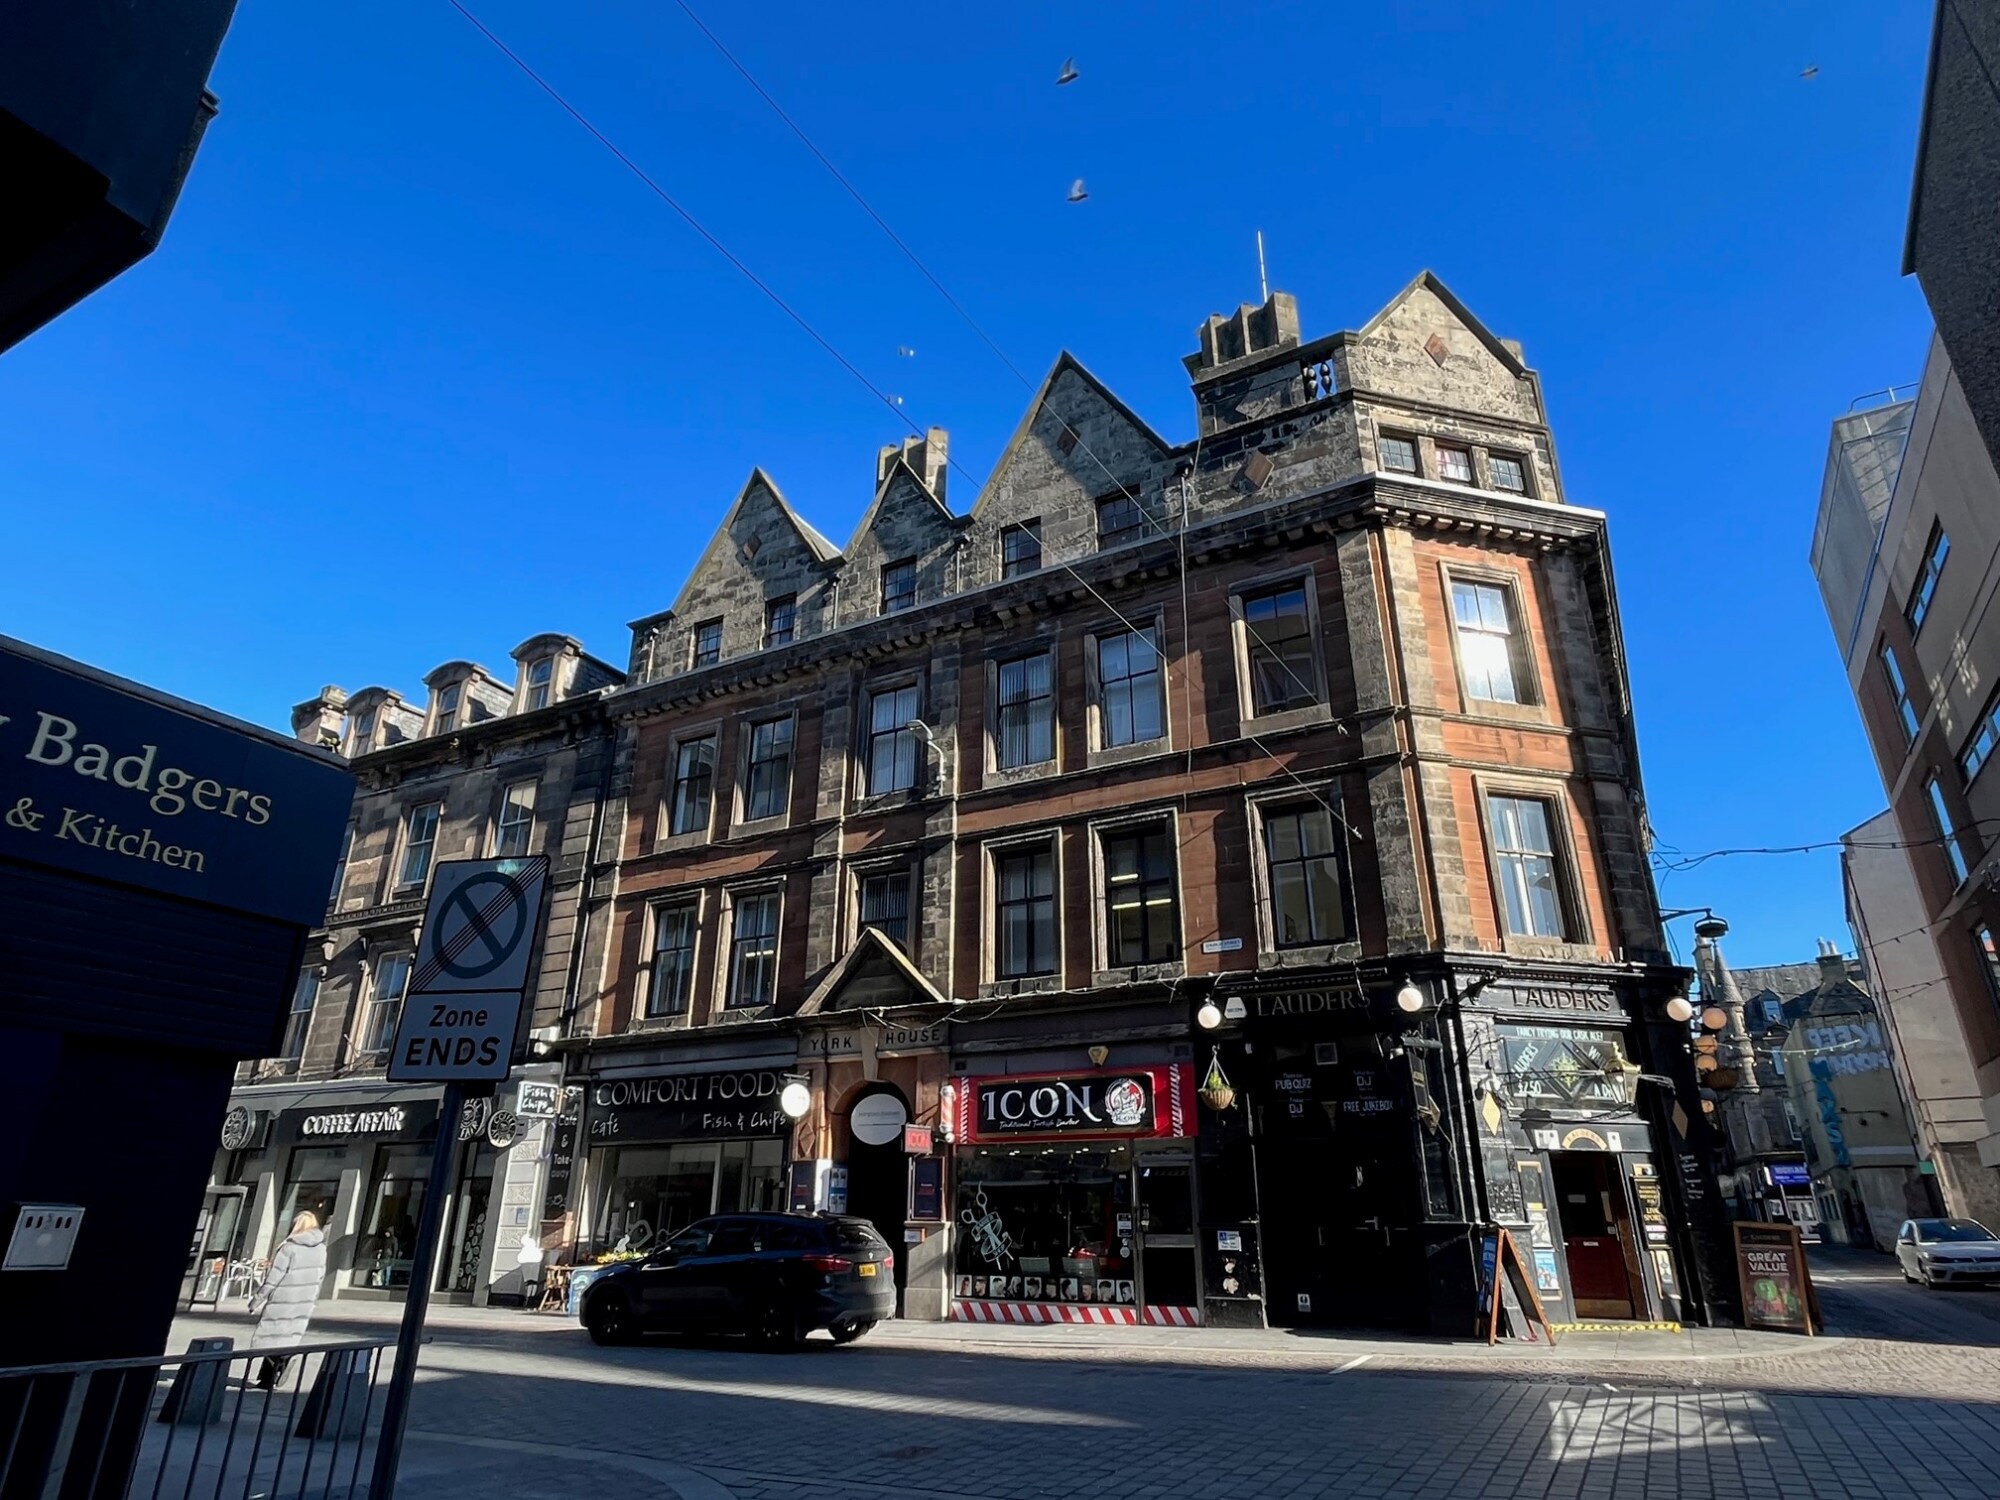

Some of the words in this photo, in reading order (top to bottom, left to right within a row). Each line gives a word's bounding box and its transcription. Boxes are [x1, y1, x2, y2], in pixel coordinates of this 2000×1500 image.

[25, 711, 274, 827] Badgers
[5, 796, 45, 833] &
[54, 807, 207, 874] Kitchen
[1257, 989, 1371, 1016] LAUDERS
[1511, 985, 1611, 1012] LAUDERS
[430, 1005, 489, 1028] Zone
[810, 1036, 852, 1051] YORK
[885, 1029, 941, 1045] HOUSE
[404, 1037, 500, 1067] ENDS
[523, 1084, 548, 1098] Fish
[595, 1075, 704, 1107] COMFORT
[1274, 1079, 1293, 1090] PUB
[1292, 1077, 1312, 1089] QUIZ
[1356, 1075, 1372, 1087] DJ
[522, 1098, 549, 1113] Chips
[981, 1080, 1104, 1124] ICON
[1288, 1103, 1304, 1114] DJ
[1343, 1100, 1360, 1112] FREE
[302, 1112, 356, 1136] COFFEE
[591, 1112, 621, 1137] Café
[702, 1112, 733, 1130] Fish
[749, 1109, 788, 1134] Chips
[560, 1133, 569, 1149] &
[1747, 1251, 1787, 1263] GREAT
[1748, 1262, 1789, 1273] VALUE
